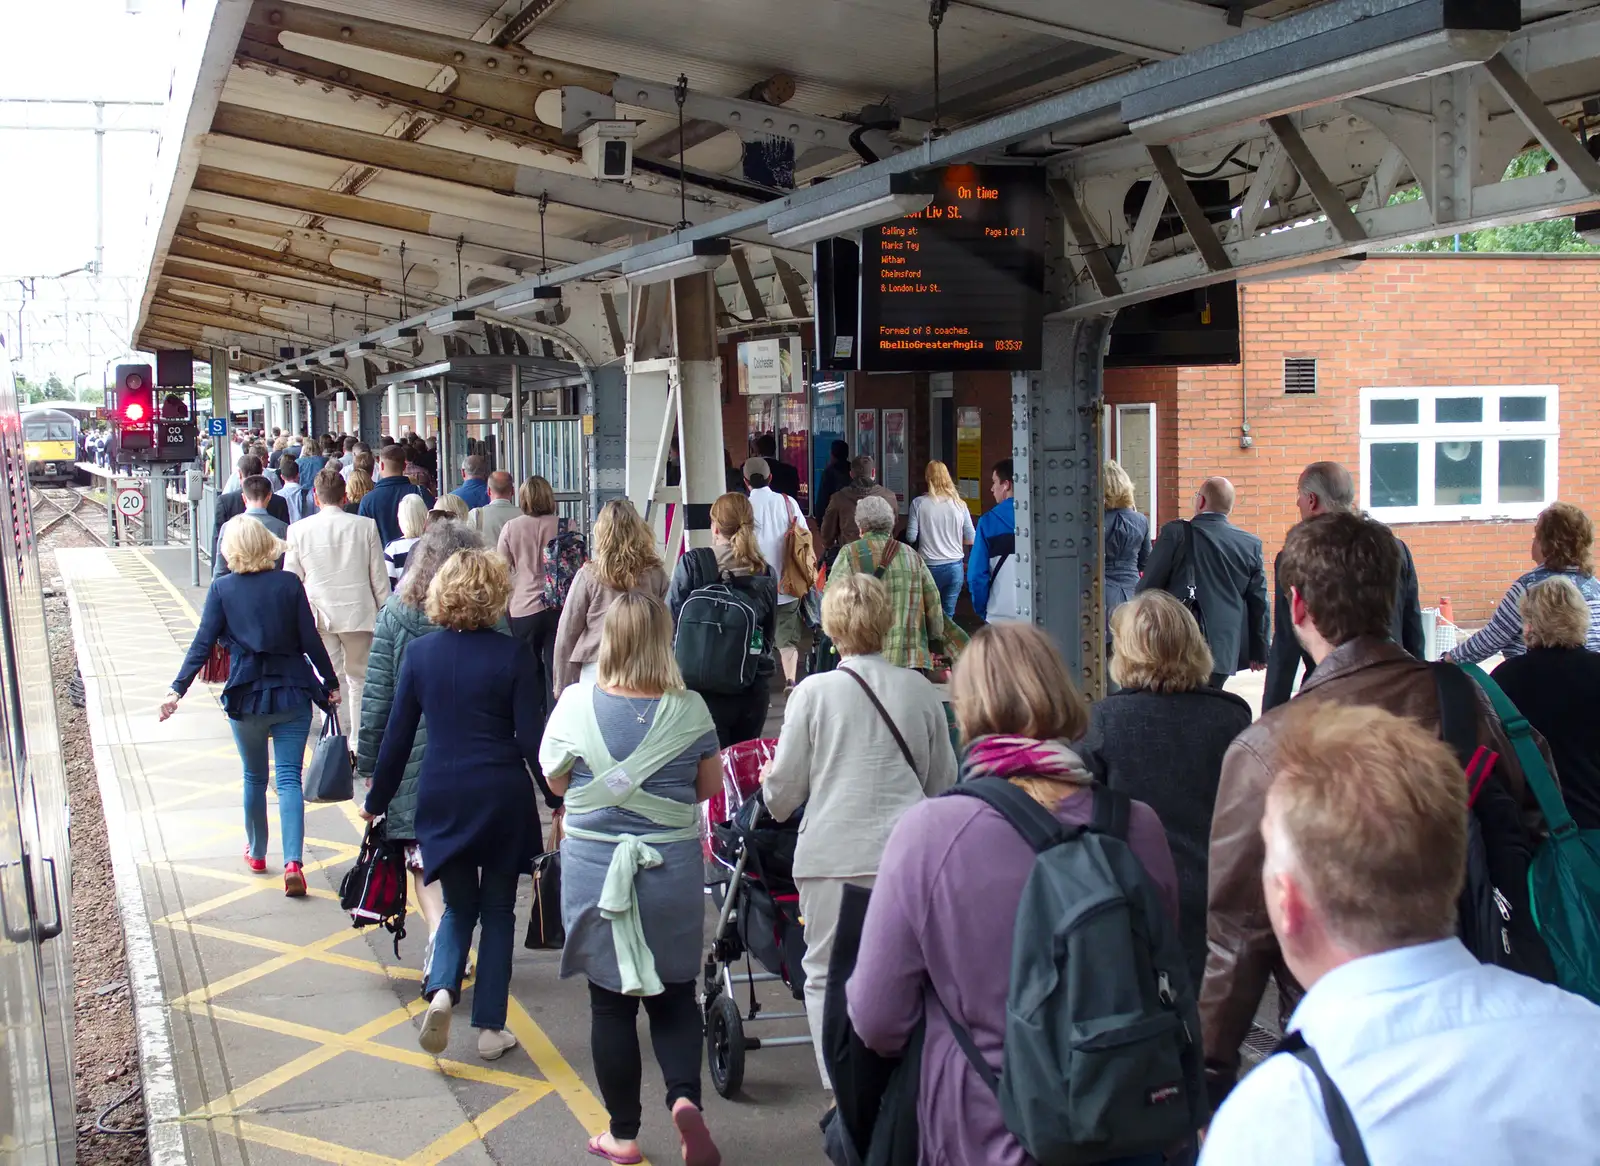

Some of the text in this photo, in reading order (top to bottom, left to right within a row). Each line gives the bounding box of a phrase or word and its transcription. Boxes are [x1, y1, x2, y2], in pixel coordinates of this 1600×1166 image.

[958, 186, 999, 199] On time
[926, 205, 943, 219] Liv
[947, 205, 962, 219] St.
[881, 226, 918, 238] Calling at:
[985, 227, 1025, 238] Page 1 of 1
[881, 240, 920, 252] Marks Tey
[881, 255, 906, 265] Witham
[880, 269, 922, 279] Chelmsford
[880, 283, 887, 293] &
[888, 283, 914, 293] London
[915, 283, 927, 293] Liv
[880, 326, 971, 335] Formed of 8 coaches.
[879, 340, 984, 351] AbellioGreaterAnglia
[168, 426, 181, 434] CO
[213, 419, 222, 432] S
[167, 435, 183, 443] 1063
[123, 496, 140, 508] 20
